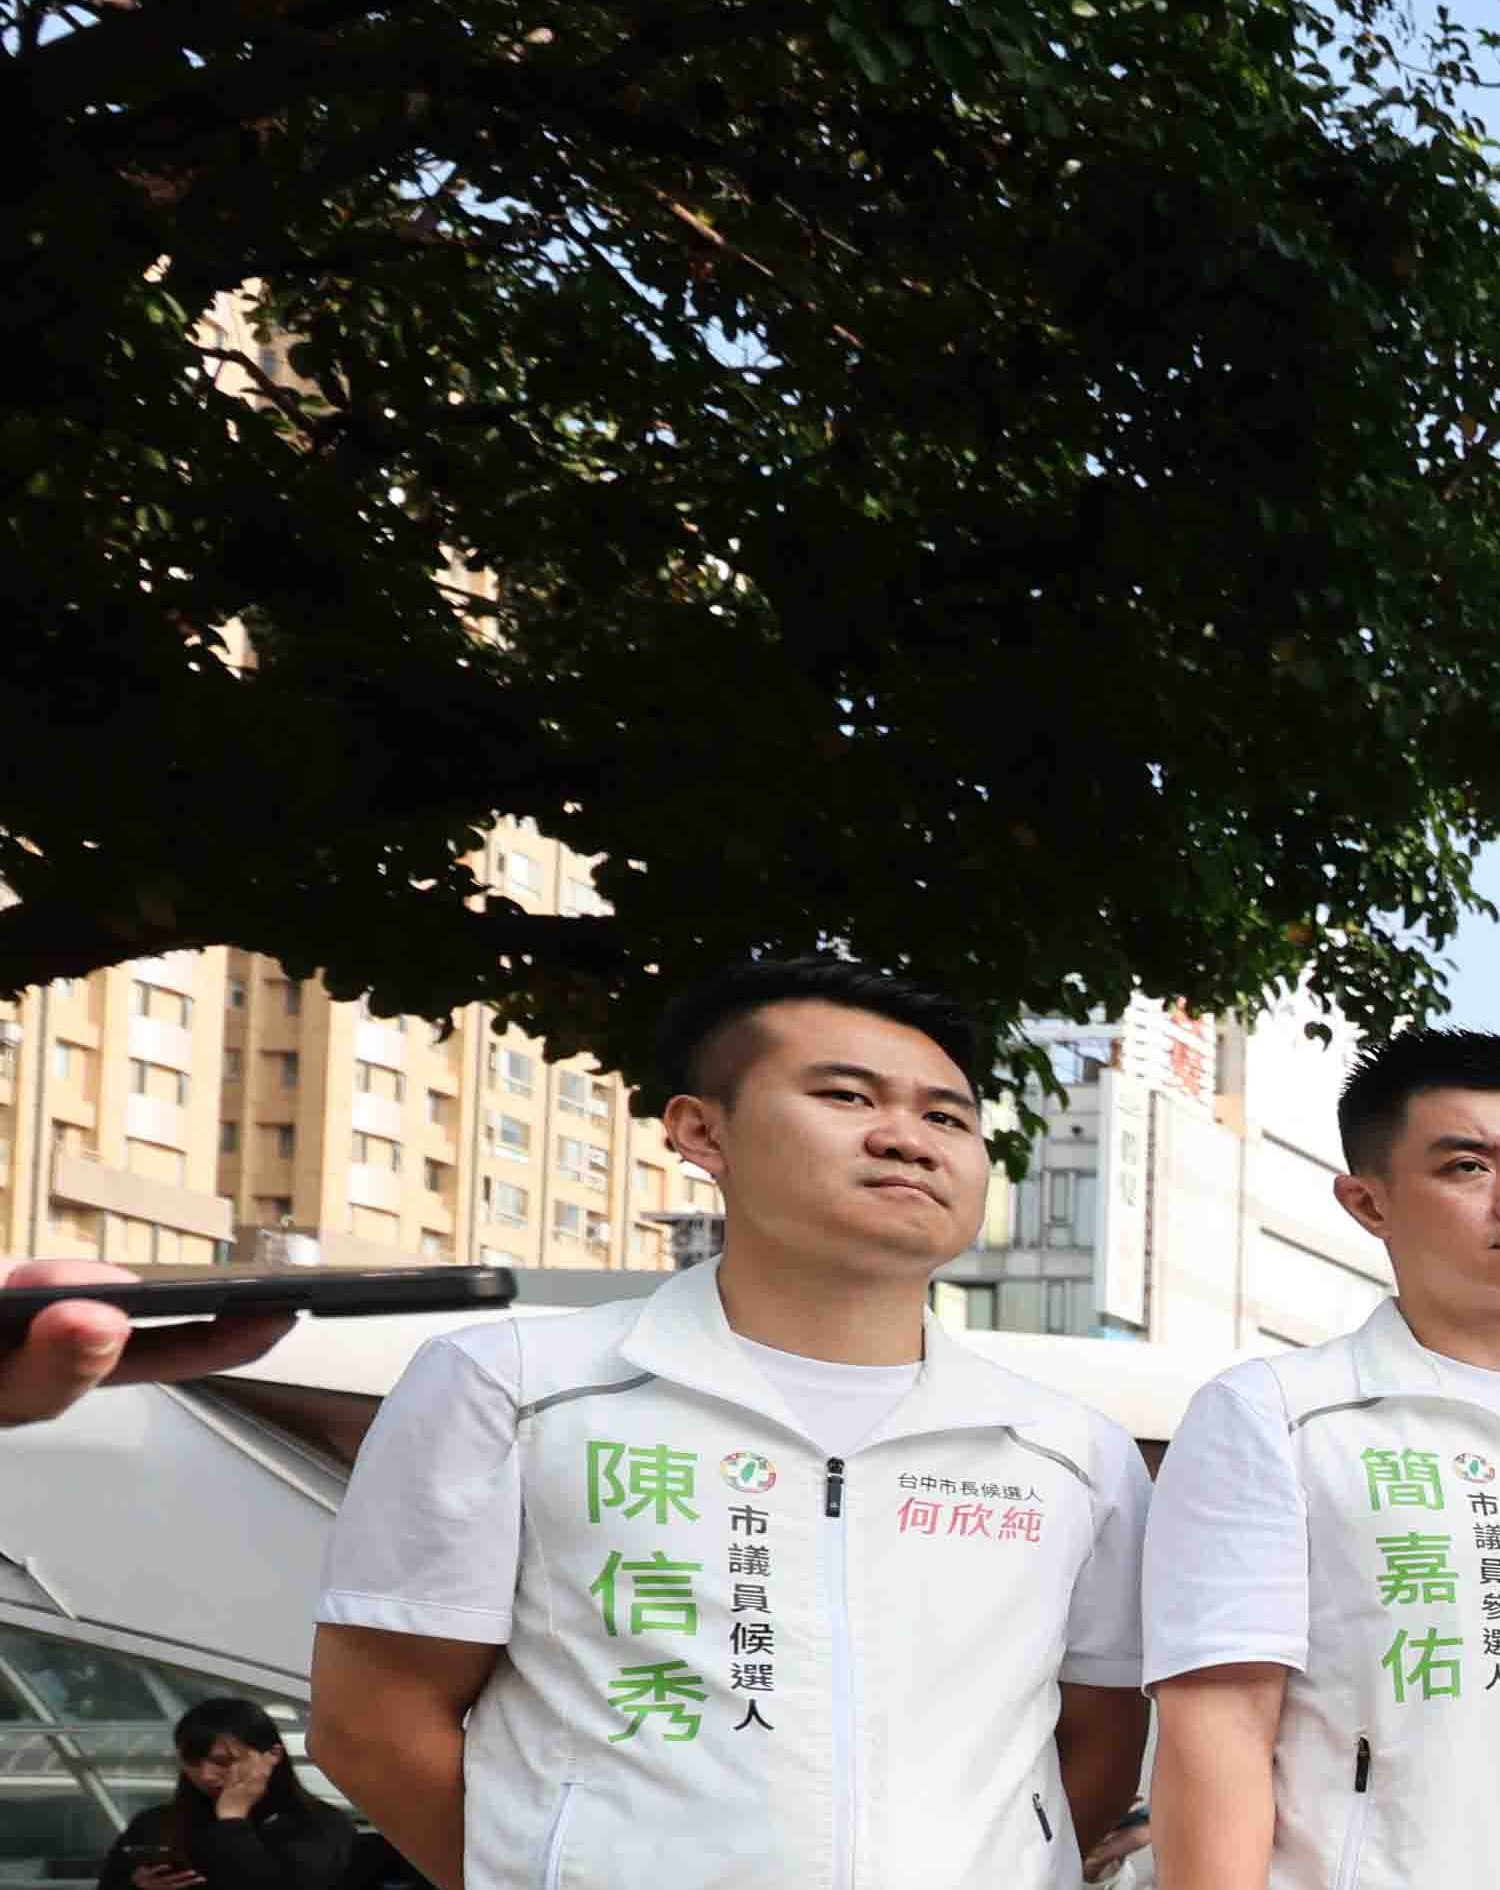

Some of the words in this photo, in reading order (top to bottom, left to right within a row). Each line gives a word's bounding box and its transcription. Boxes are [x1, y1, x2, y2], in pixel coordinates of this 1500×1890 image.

[586, 1439, 708, 1743] 陳信秀
[896, 1471, 1043, 1503] 台中市長候選人
[897, 1497, 1043, 1542] 何欣純
[1359, 1447, 1464, 1702] 簡嘉佑
[727, 1505, 776, 1733] 市議員候選人
